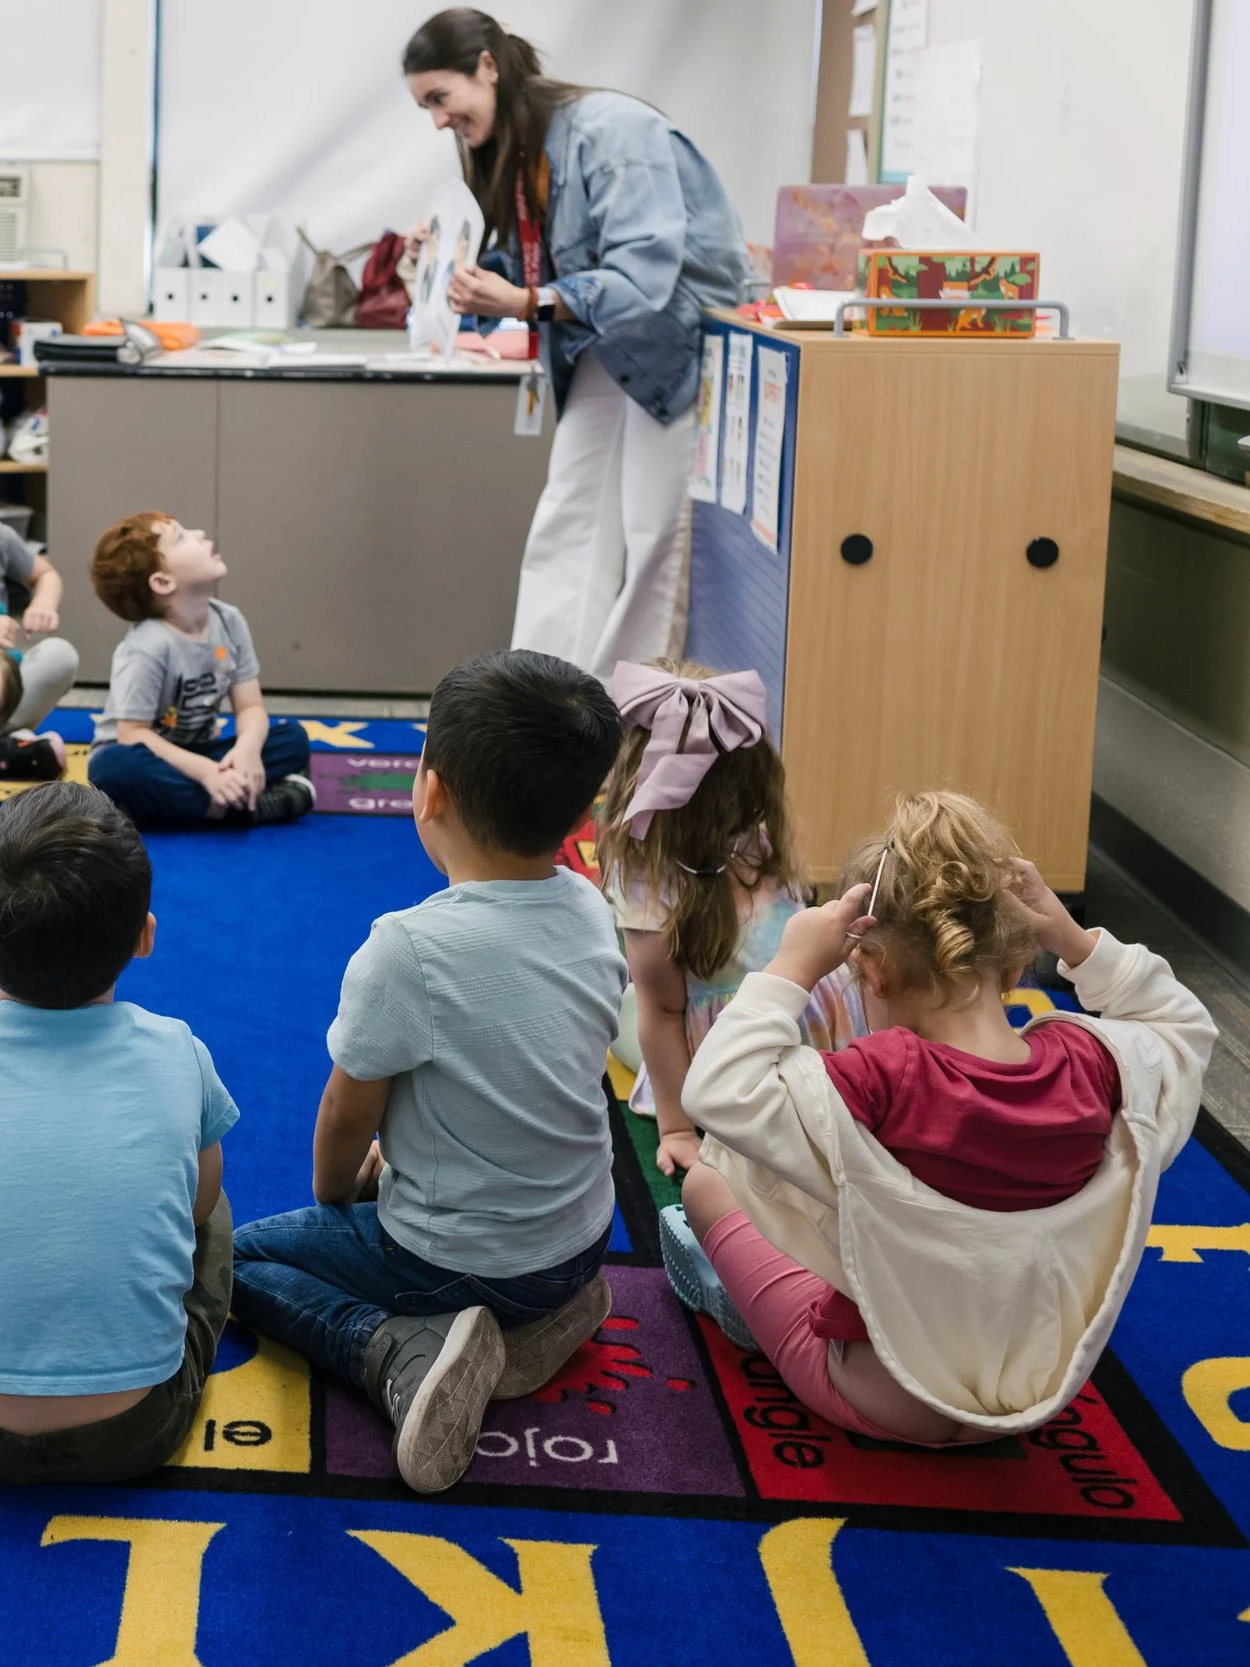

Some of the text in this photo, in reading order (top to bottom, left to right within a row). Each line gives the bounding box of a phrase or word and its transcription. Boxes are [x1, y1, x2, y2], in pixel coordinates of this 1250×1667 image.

[201, 1419, 273, 1452] el
[475, 1427, 619, 1468] rojo
[740, 1355, 832, 1469] angle
[39, 1514, 228, 1667] L
